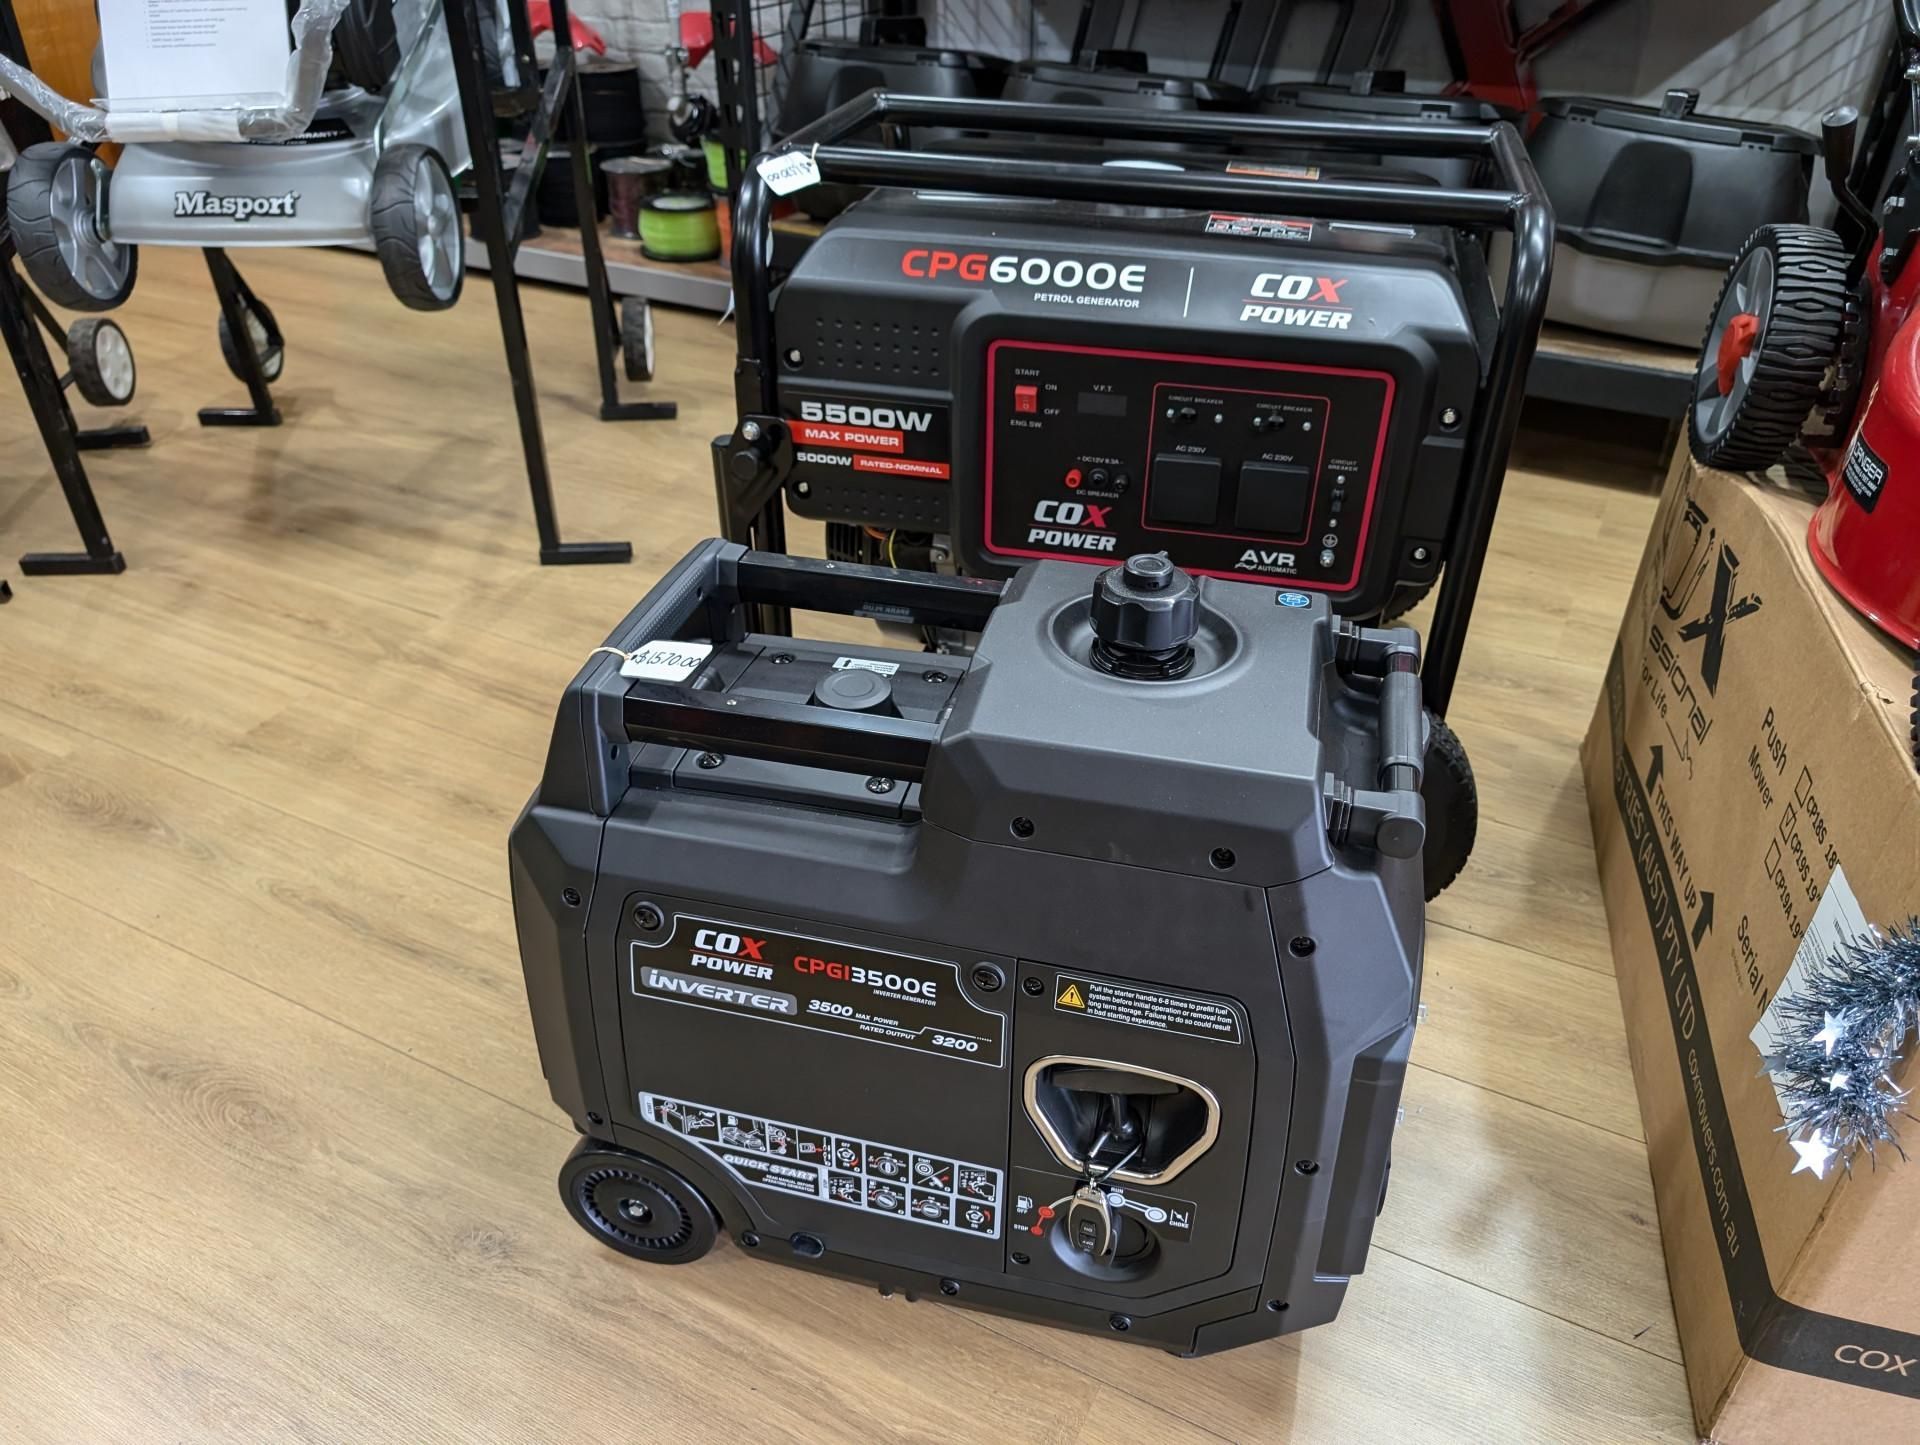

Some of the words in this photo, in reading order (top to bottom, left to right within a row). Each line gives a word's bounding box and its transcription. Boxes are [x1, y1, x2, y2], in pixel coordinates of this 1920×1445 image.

[175, 192, 298, 220] Masport
[901, 250, 1146, 293] CPG6000E
[1034, 292, 1075, 305] PETROL
[1076, 295, 1140, 309] GENERATOR
[1250, 273, 1349, 304] COX
[1239, 305, 1352, 330] POWER
[1015, 368, 1040, 377] START
[1044, 408, 1060, 416] OFF
[1168, 395, 1193, 403] CIRCUIT
[1195, 397, 1223, 405] BREAKER
[1256, 403, 1282, 411] CIRCUIT
[1283, 405, 1313, 413] BREAKER
[801, 401, 932, 432] 5500W
[805, 428, 841, 441] MAX
[844, 432, 899, 447] POWER
[1176, 444, 1187, 453] AC
[1187, 446, 1206, 454] 230V
[797, 451, 852, 467] 5000W
[860, 459, 943, 475] RATED-NOMINAL
[1262, 452, 1273, 461] AC
[1274, 454, 1293, 462] 230V
[1034, 500, 1112, 528] COX
[1028, 529, 1116, 551] POWER
[1240, 549, 1295, 566] AVR
[1258, 565, 1297, 575] AUTOMATIC
[634, 652, 702, 668] $1570.00
[1649, 679, 1668, 719] Life
[1761, 706, 1788, 776] Push
[1748, 744, 1774, 810] Mower
[1806, 795, 1828, 845] CP18S
[1655, 784, 1675, 838] THIS
[1670, 827, 1690, 881] WAY
[1684, 877, 1697, 911] UP
[1790, 832, 1810, 882] CP19S
[1774, 869, 1793, 920] CP19A
[694, 929, 767, 960] COX
[1638, 831, 1668, 929] (AUST)
[1662, 915, 1683, 977] PTY
[1674, 971, 1696, 1040] LTD
[691, 954, 774, 980] POWER
[1737, 915, 1764, 996] Serial
[873, 988, 901, 1000] INVERTER
[902, 993, 937, 1007] GENERATOR
[1088, 992, 1111, 1002] system
[1112, 996, 1133, 1006] before
[1133, 1000, 1151, 1009] initial
[1151, 1005, 1182, 1015] operation
[1190, 1012, 1216, 1021] removal
[1217, 1016, 1232, 1024] from
[1090, 984, 1102, 993] Pull
[1103, 987, 1114, 995] the
[1114, 989, 1135, 999] starter
[1135, 993, 1157, 1003] handle
[1170, 1000, 1188, 1008] times
[1196, 1005, 1215, 1013] prefill
[1215, 1007, 1228, 1015] fuel
[808, 999, 853, 1017] 3500
[855, 1012, 871, 1021] MAX
[873, 1016, 899, 1026] POWER
[1088, 1000, 1102, 1009] long
[1118, 1006, 1144, 1016] storage.
[1144, 1010, 1167, 1020] Failure
[1175, 1015, 1184, 1023] do
[1193, 1020, 1212, 1029] could
[1212, 1022, 1231, 1032] result
[1094, 1009, 1106, 1017] bad
[1107, 1011, 1130, 1022] starting
[1131, 1016, 1167, 1029] experience.
[859, 1024, 885, 1034] RATED
[885, 1029, 916, 1040] OUTPUT
[931, 1034, 979, 1052] 3200
[1688, 1048, 1740, 1259] coxmowers.com.au
[723, 1154, 770, 1172] QUICK
[769, 1164, 818, 1181] START
[1834, 1344, 1918, 1376] COX
